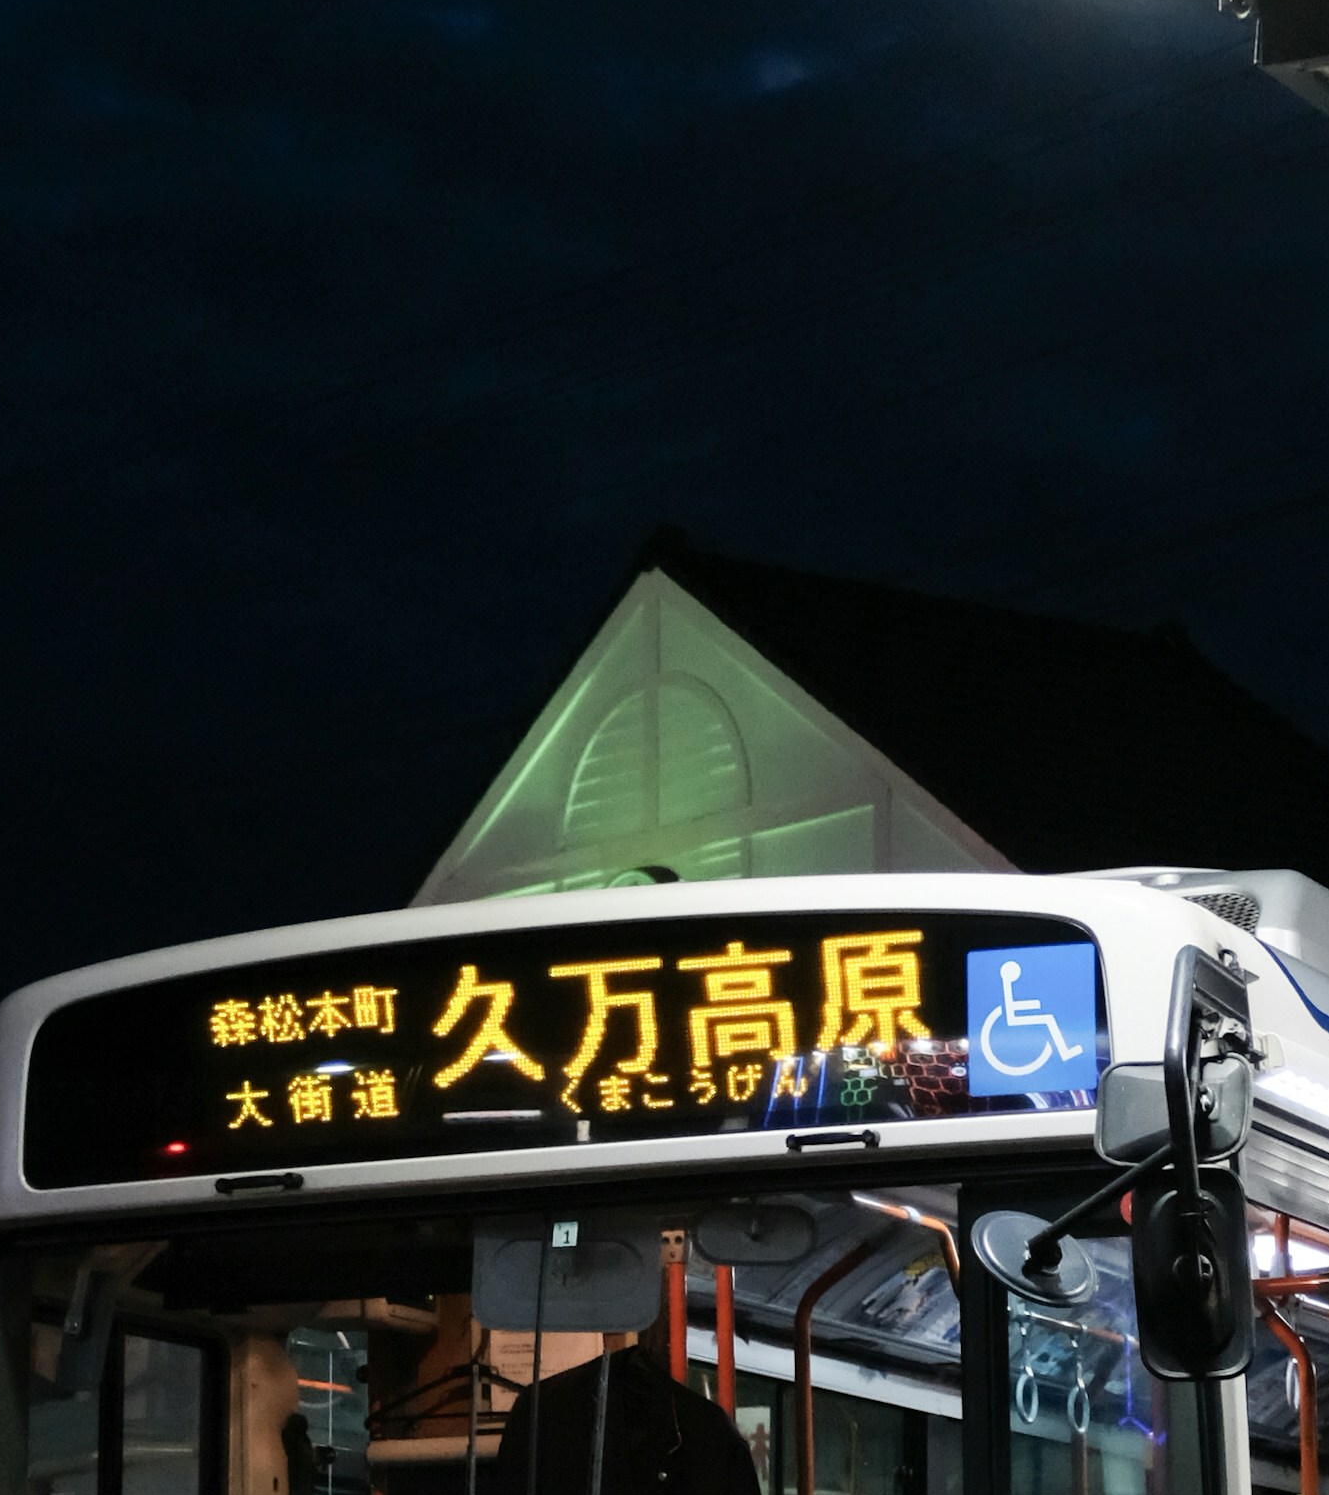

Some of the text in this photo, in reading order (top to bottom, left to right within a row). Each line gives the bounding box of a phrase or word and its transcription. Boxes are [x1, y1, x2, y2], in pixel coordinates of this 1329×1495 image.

[209, 986, 398, 1047] 森松本町
[431, 930, 934, 1089] 久万高原
[225, 1068, 400, 1129] 大街道
